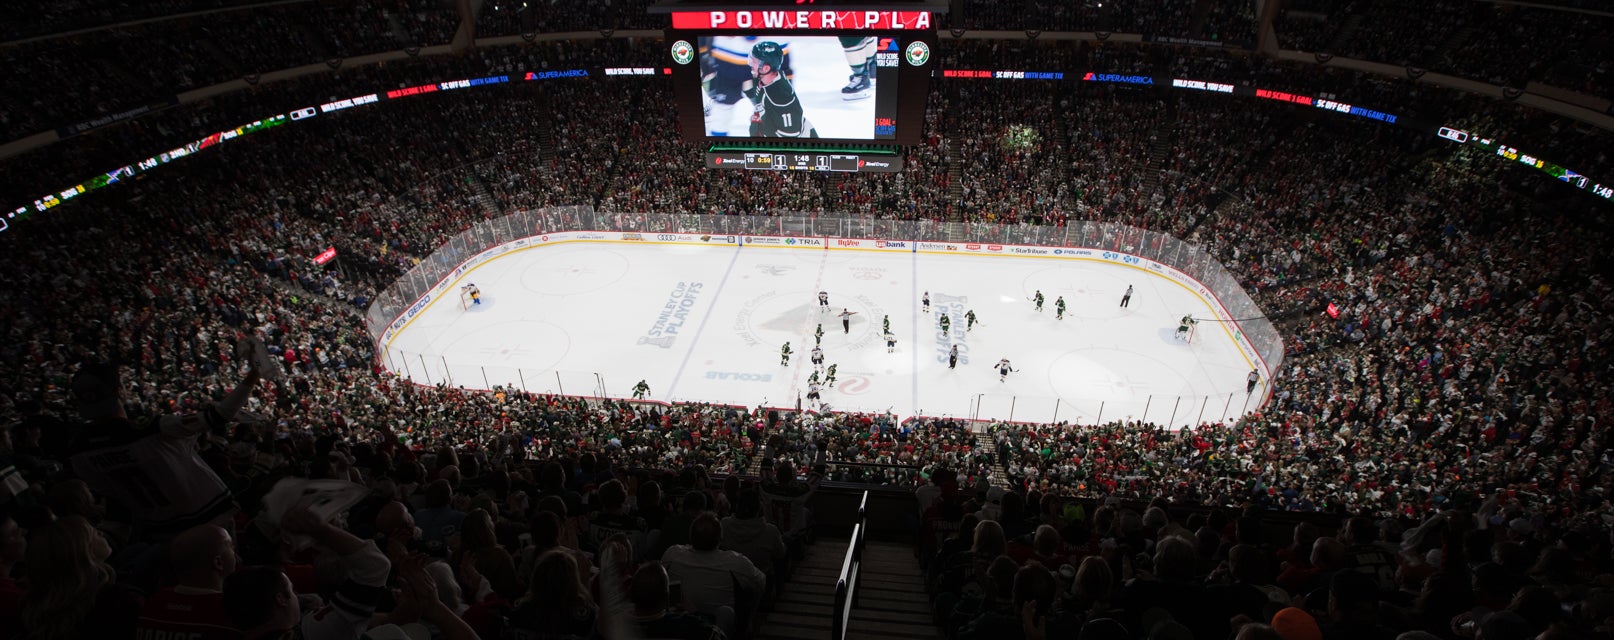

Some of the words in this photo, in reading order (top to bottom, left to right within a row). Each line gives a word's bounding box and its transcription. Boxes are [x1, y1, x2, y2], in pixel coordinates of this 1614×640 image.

[710, 11, 836, 28] POWER
[865, 11, 930, 28] PLA
[539, 69, 589, 79] SUPERAMERICA
[957, 70, 974, 78] SCORE
[978, 70, 992, 78] GOAL
[1003, 71, 1013, 79] OFF
[1013, 71, 1025, 79] GAS
[1098, 74, 1153, 85] SUPERAMERICA
[448, 81, 458, 89] OFF
[458, 79, 470, 88] GAS
[470, 78, 484, 86] WITH
[484, 76, 500, 84] GAME
[1173, 79, 1188, 88] WILD
[1207, 82, 1218, 91] YOU
[386, 89, 402, 98] WILD
[401, 87, 419, 96] SCORE
[423, 84, 438, 92] GOAL
[1256, 89, 1272, 98] WILD
[1272, 91, 1292, 101] SCORE
[1296, 95, 1313, 105] GOAL
[1325, 101, 1338, 110] OFF
[1336, 102, 1351, 113] GAS
[1350, 106, 1369, 117] WITH
[1367, 110, 1386, 121] GAME
[1386, 113, 1398, 124] TIX
[781, 113, 792, 127] 11
[138, 157, 158, 170] 1:48
[1520, 154, 1537, 165] SOG
[1592, 183, 1613, 199] 1:48
[678, 232, 692, 240] Audi
[407, 294, 431, 318] GEICO
[648, 299, 679, 337] STANLEY
[671, 281, 687, 299] CUP
[664, 281, 704, 335] PLAYOFFS
[950, 303, 967, 342] STANLEY
[704, 371, 773, 382] ECOLAB
